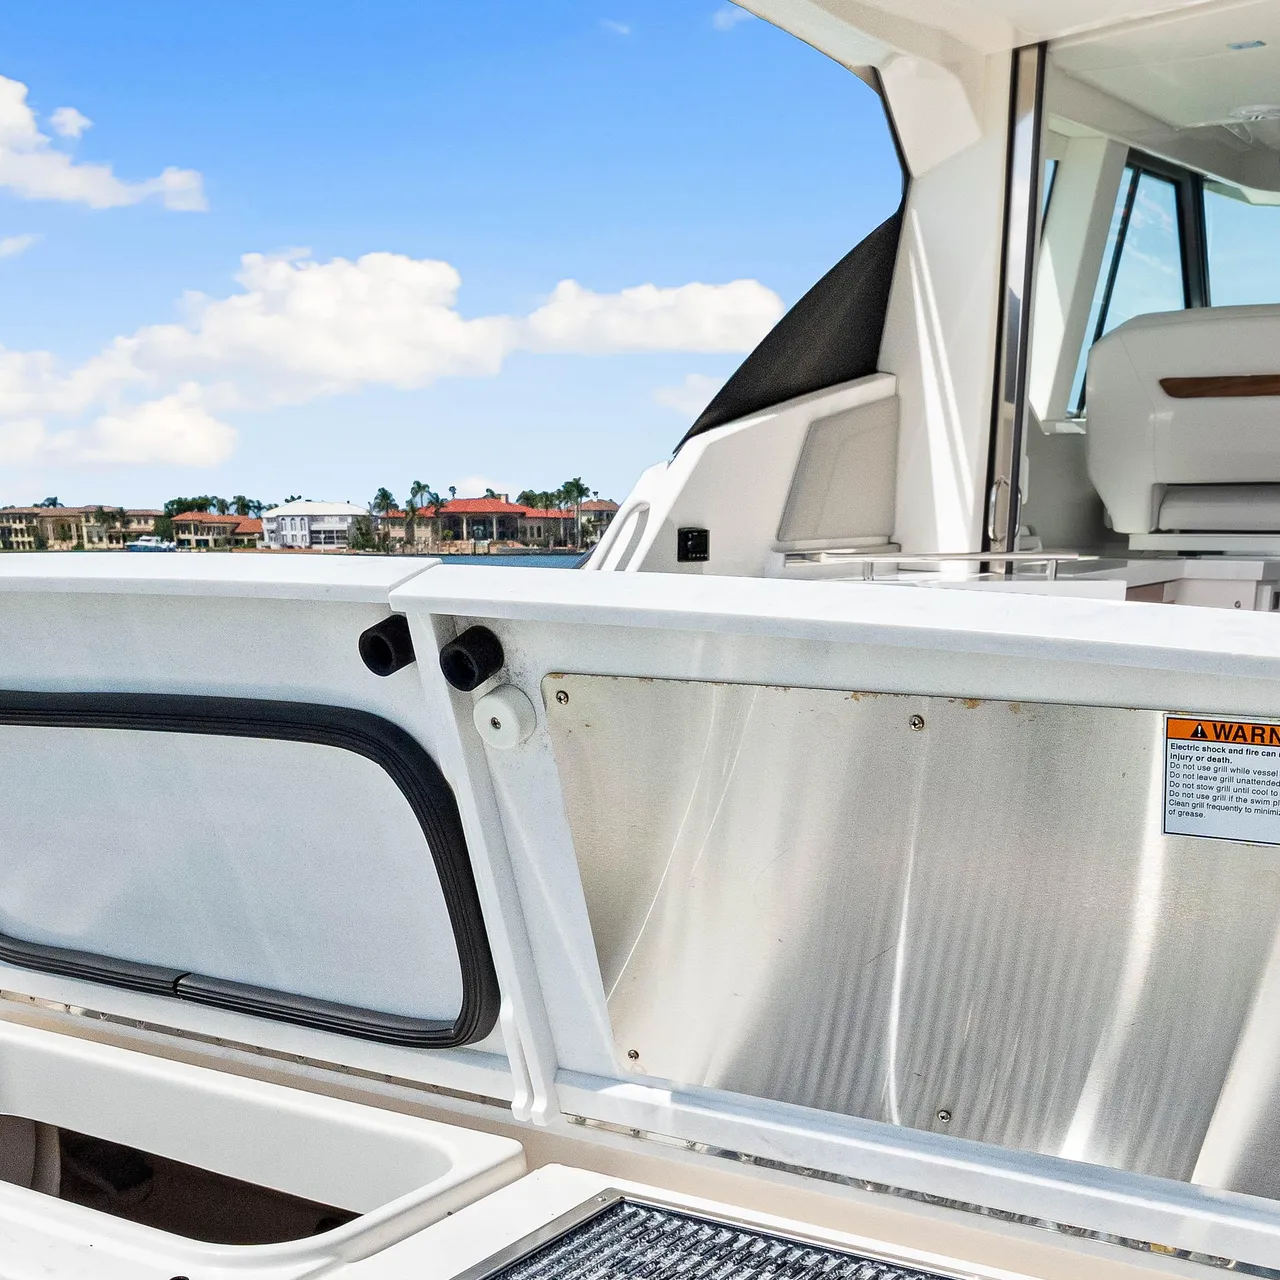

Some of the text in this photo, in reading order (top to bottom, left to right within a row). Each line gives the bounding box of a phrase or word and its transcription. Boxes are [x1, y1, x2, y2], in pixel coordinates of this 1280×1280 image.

[1170, 742, 1200, 752] Electric
[1202, 746, 1226, 754] shock
[1170, 753, 1193, 762] injury
[1207, 756, 1232, 764] death.
[1213, 766, 1227, 774] grill
[1197, 774, 1217, 782] leave
[1236, 778, 1280, 787] unattended
[1236, 796, 1248, 804] the
[1169, 799, 1190, 807] Clean
[1206, 803, 1242, 813] frequently
[1178, 810, 1206, 818] grease.
